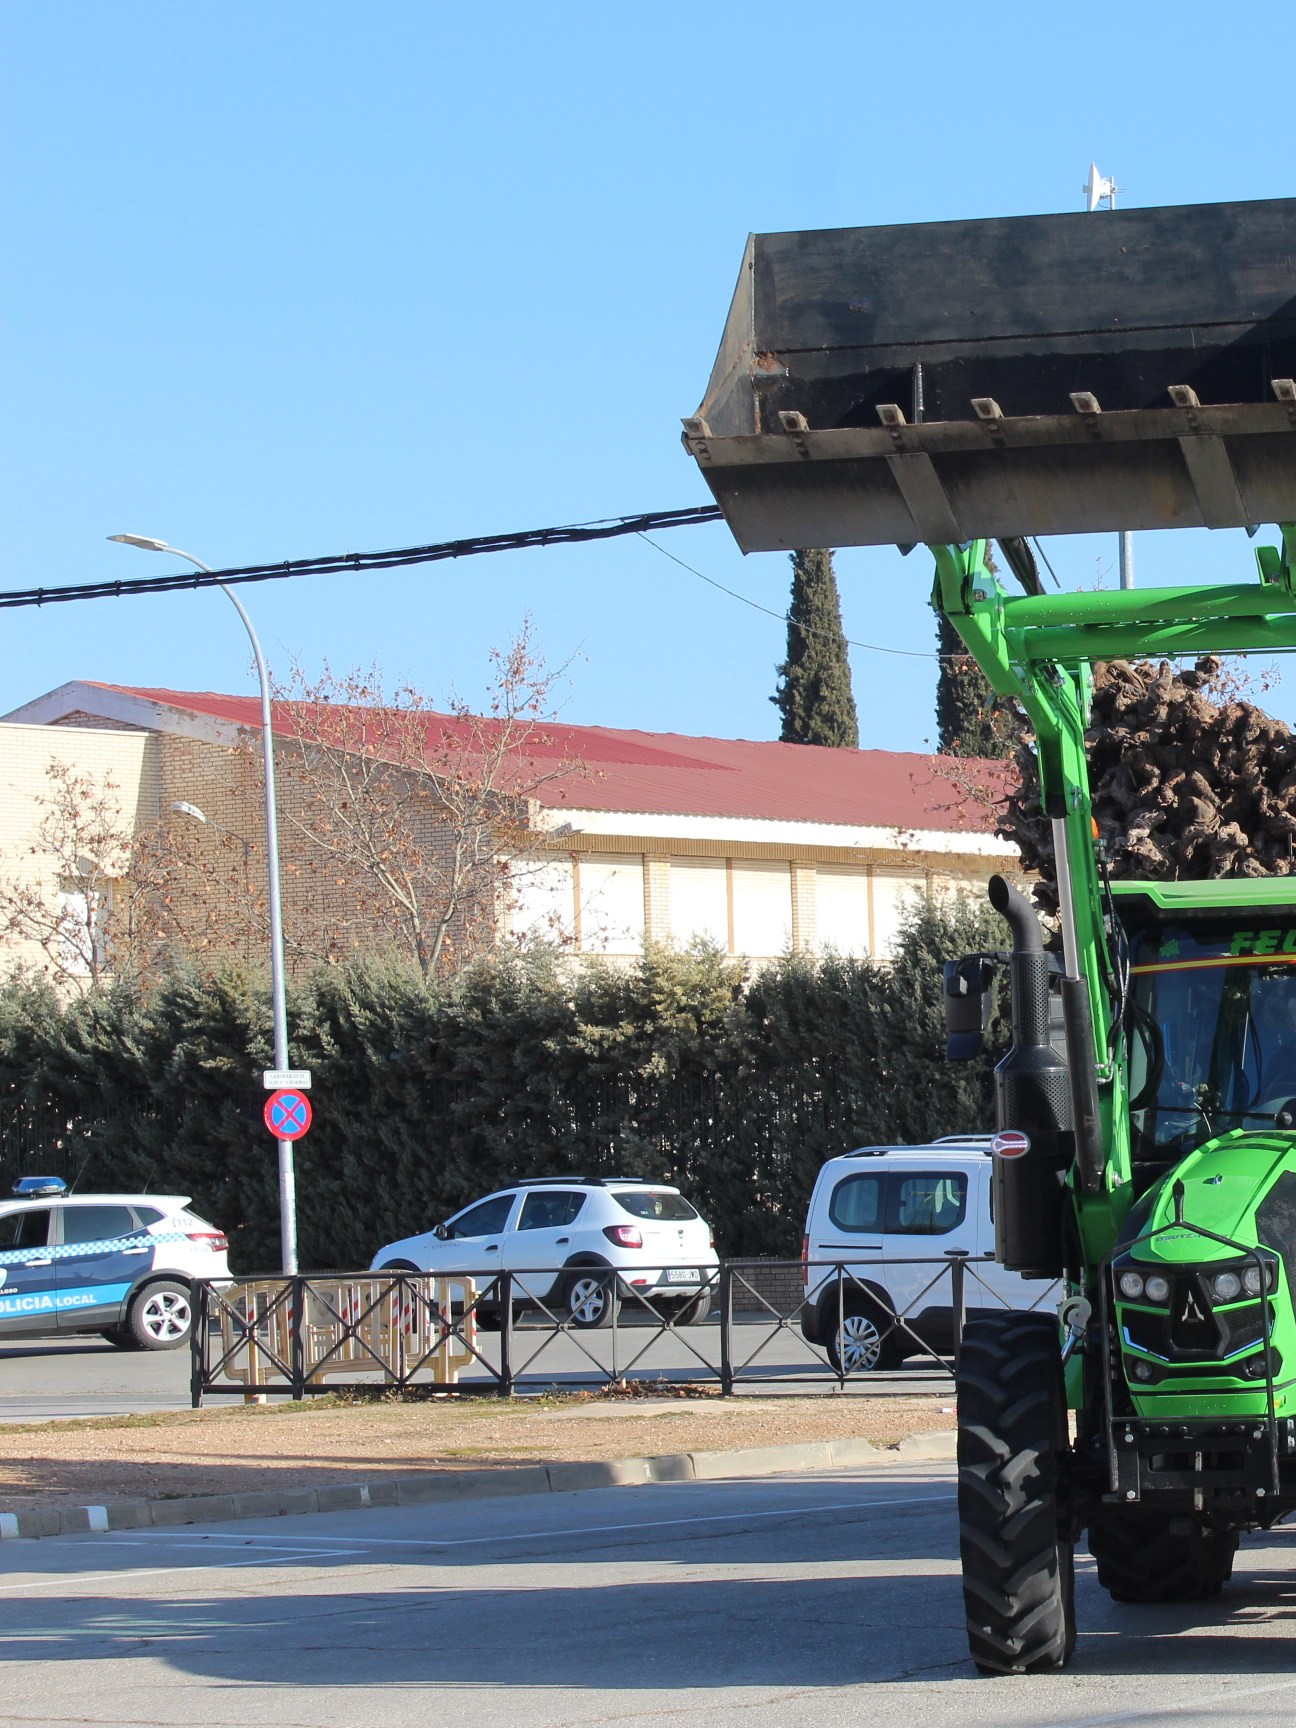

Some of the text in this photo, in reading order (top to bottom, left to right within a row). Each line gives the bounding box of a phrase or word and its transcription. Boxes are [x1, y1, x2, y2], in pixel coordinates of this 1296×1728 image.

[176, 1218, 193, 1226] 112
[0, 1287, 19, 1295] LOSO
[56, 1294, 98, 1307] LOCAL
